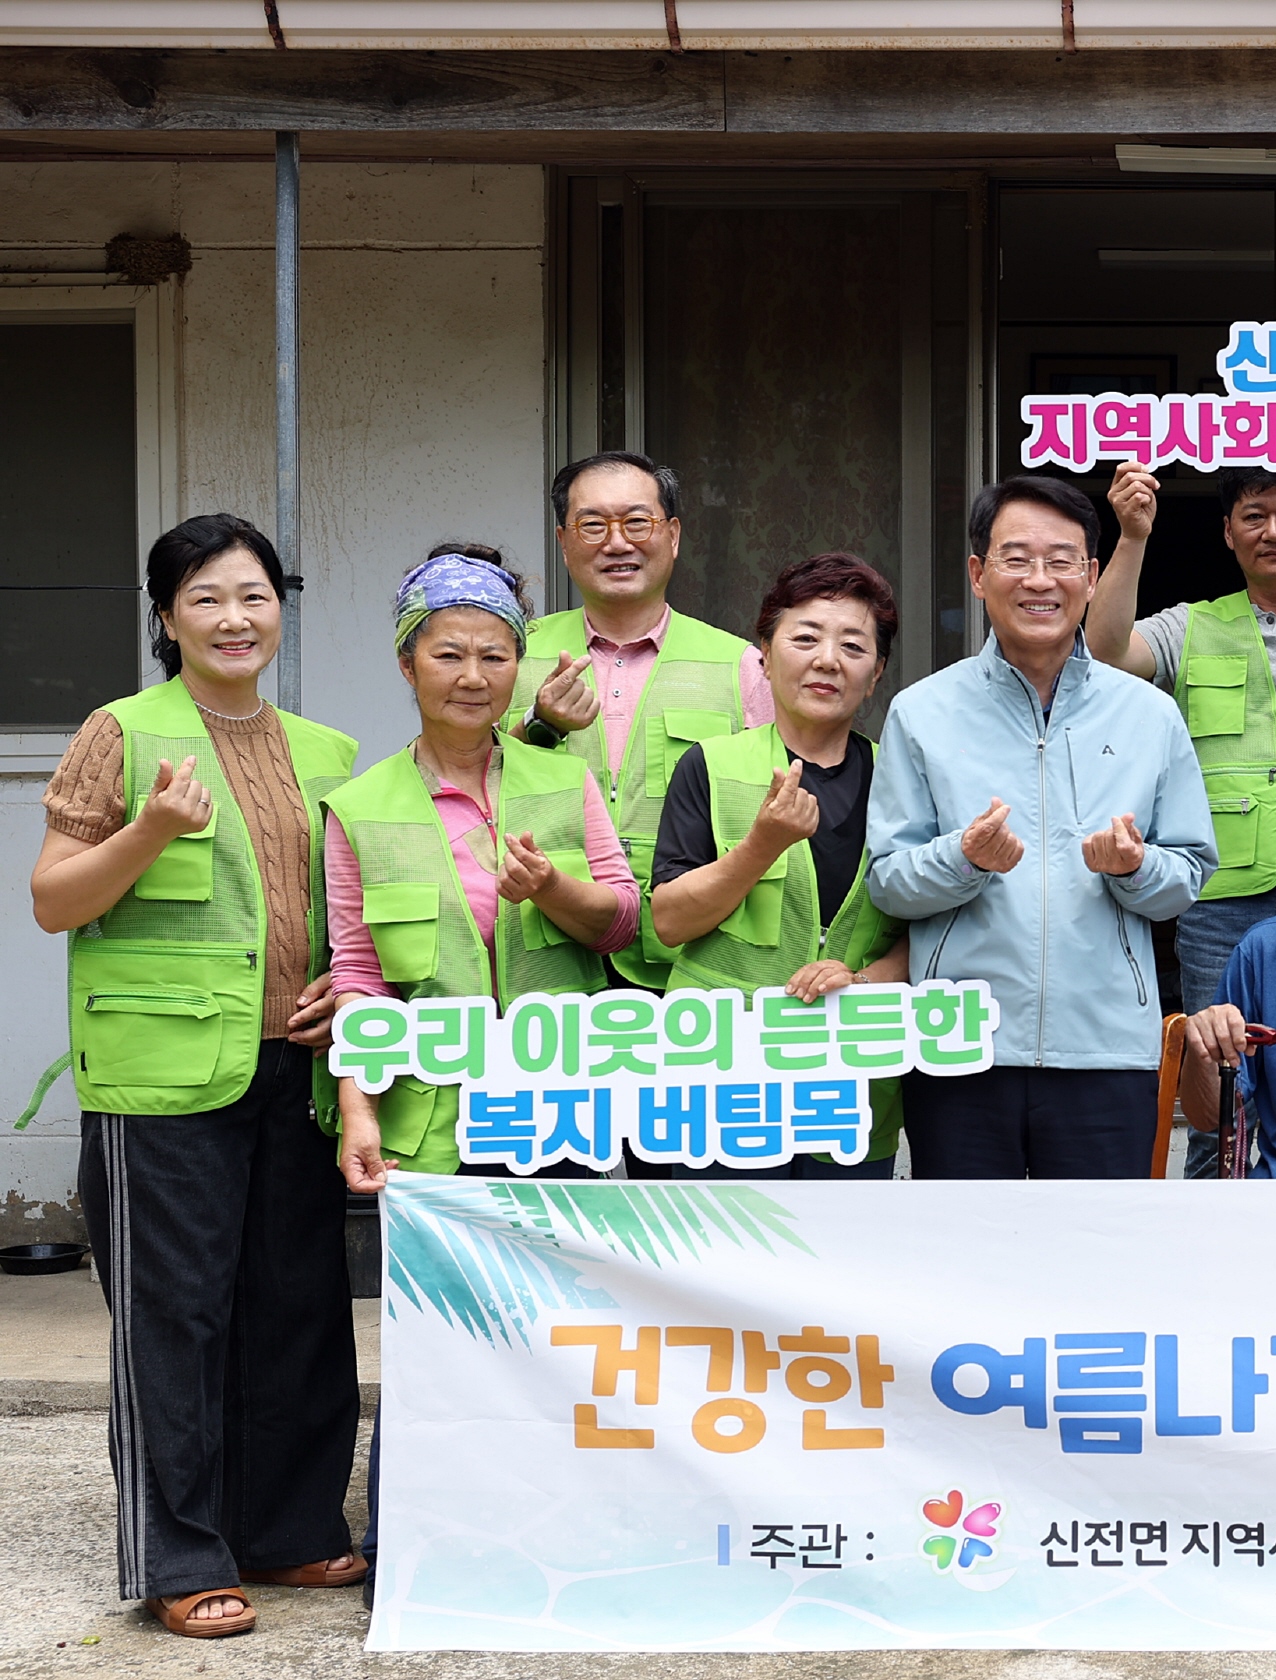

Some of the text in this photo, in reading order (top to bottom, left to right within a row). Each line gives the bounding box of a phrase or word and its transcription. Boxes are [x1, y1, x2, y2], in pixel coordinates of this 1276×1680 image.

[339, 988, 990, 1084] 우리 이웃의 든든한
[466, 1079, 861, 1165] 복지 버팀목
[550, 1324, 895, 1454] 건강한
[750, 1523, 848, 1570] 주관
[1040, 1520, 1168, 1567] 신전면
